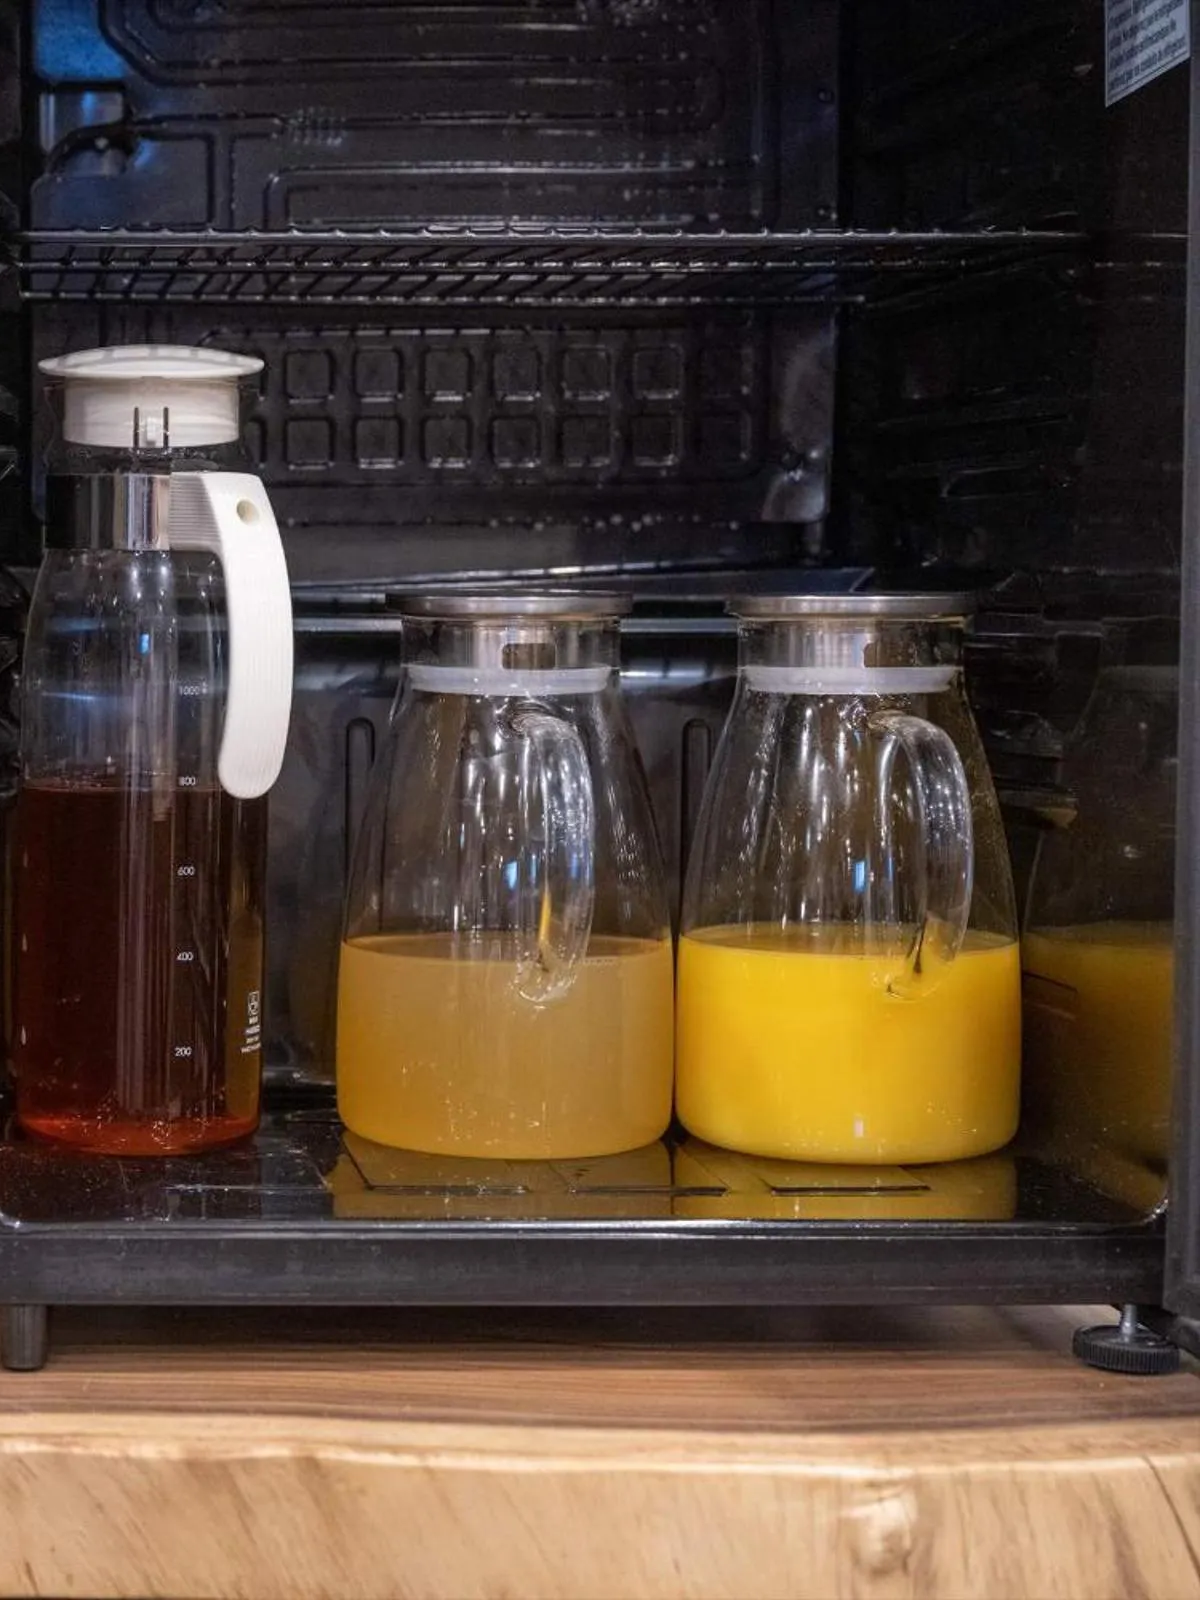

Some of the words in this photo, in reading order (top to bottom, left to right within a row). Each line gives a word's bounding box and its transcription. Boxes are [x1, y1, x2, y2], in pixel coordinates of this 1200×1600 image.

[177, 866, 195, 876] 600
[176, 951, 194, 961] 400
[174, 1046, 192, 1057] 200
